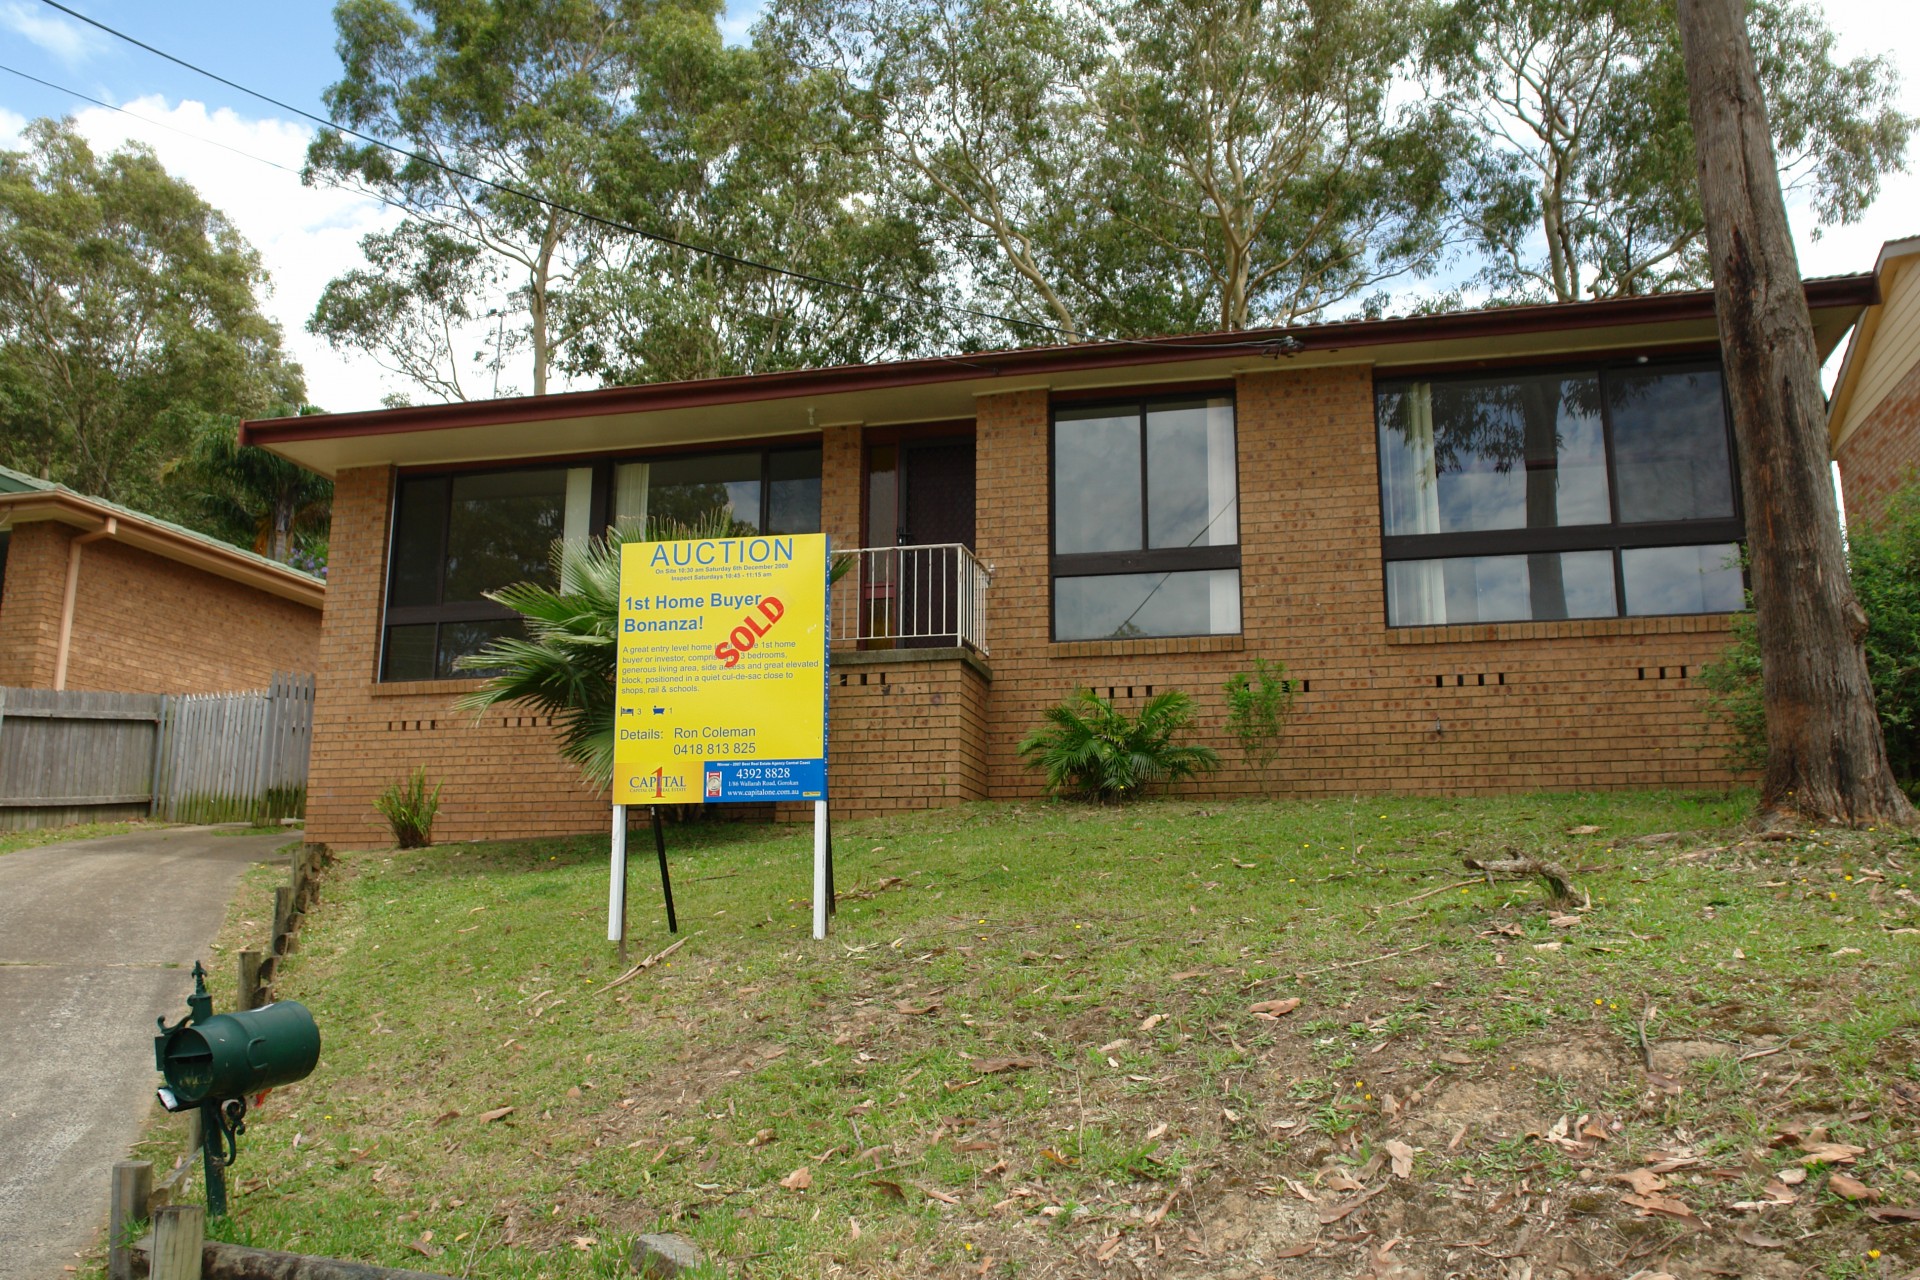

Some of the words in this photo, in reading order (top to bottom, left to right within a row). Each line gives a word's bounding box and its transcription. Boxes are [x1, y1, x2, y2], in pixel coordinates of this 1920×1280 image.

[650, 538, 793, 567] AUCTION
[625, 596, 650, 610] 1st
[656, 595, 704, 609] Home
[711, 592, 761, 610] Buyer
[624, 616, 703, 632] Bonanza!
[715, 596, 784, 668] SOLD
[630, 646, 649, 655] great
[651, 645, 669, 653] entry
[692, 643, 712, 651] home
[761, 641, 772, 649] 1st
[775, 640, 796, 648] home
[623, 657, 642, 665] buyer
[655, 655, 686, 663] investor,
[747, 651, 787, 659] bedrooms,
[622, 667, 656, 675] generous
[659, 665, 678, 673] living
[764, 662, 784, 670] great
[786, 660, 819, 668] elevated
[622, 676, 643, 685] block,
[646, 675, 683, 684] positioned
[702, 675, 720, 683] quiet
[622, 687, 645, 695] shops,
[669, 685, 699, 693] schools.
[620, 729, 663, 740] Details:
[674, 728, 698, 739] Ron
[702, 727, 756, 738] Coleman
[673, 744, 703, 755] 0418
[707, 743, 729, 754] 813
[733, 742, 756, 754] 825
[736, 768, 762, 779] 4392
[765, 768, 791, 778] 8828
[629, 776, 686, 788] CAPITAL
[651, 766, 666, 799] 1
[727, 789, 799, 797] www.capitalone.com.au
